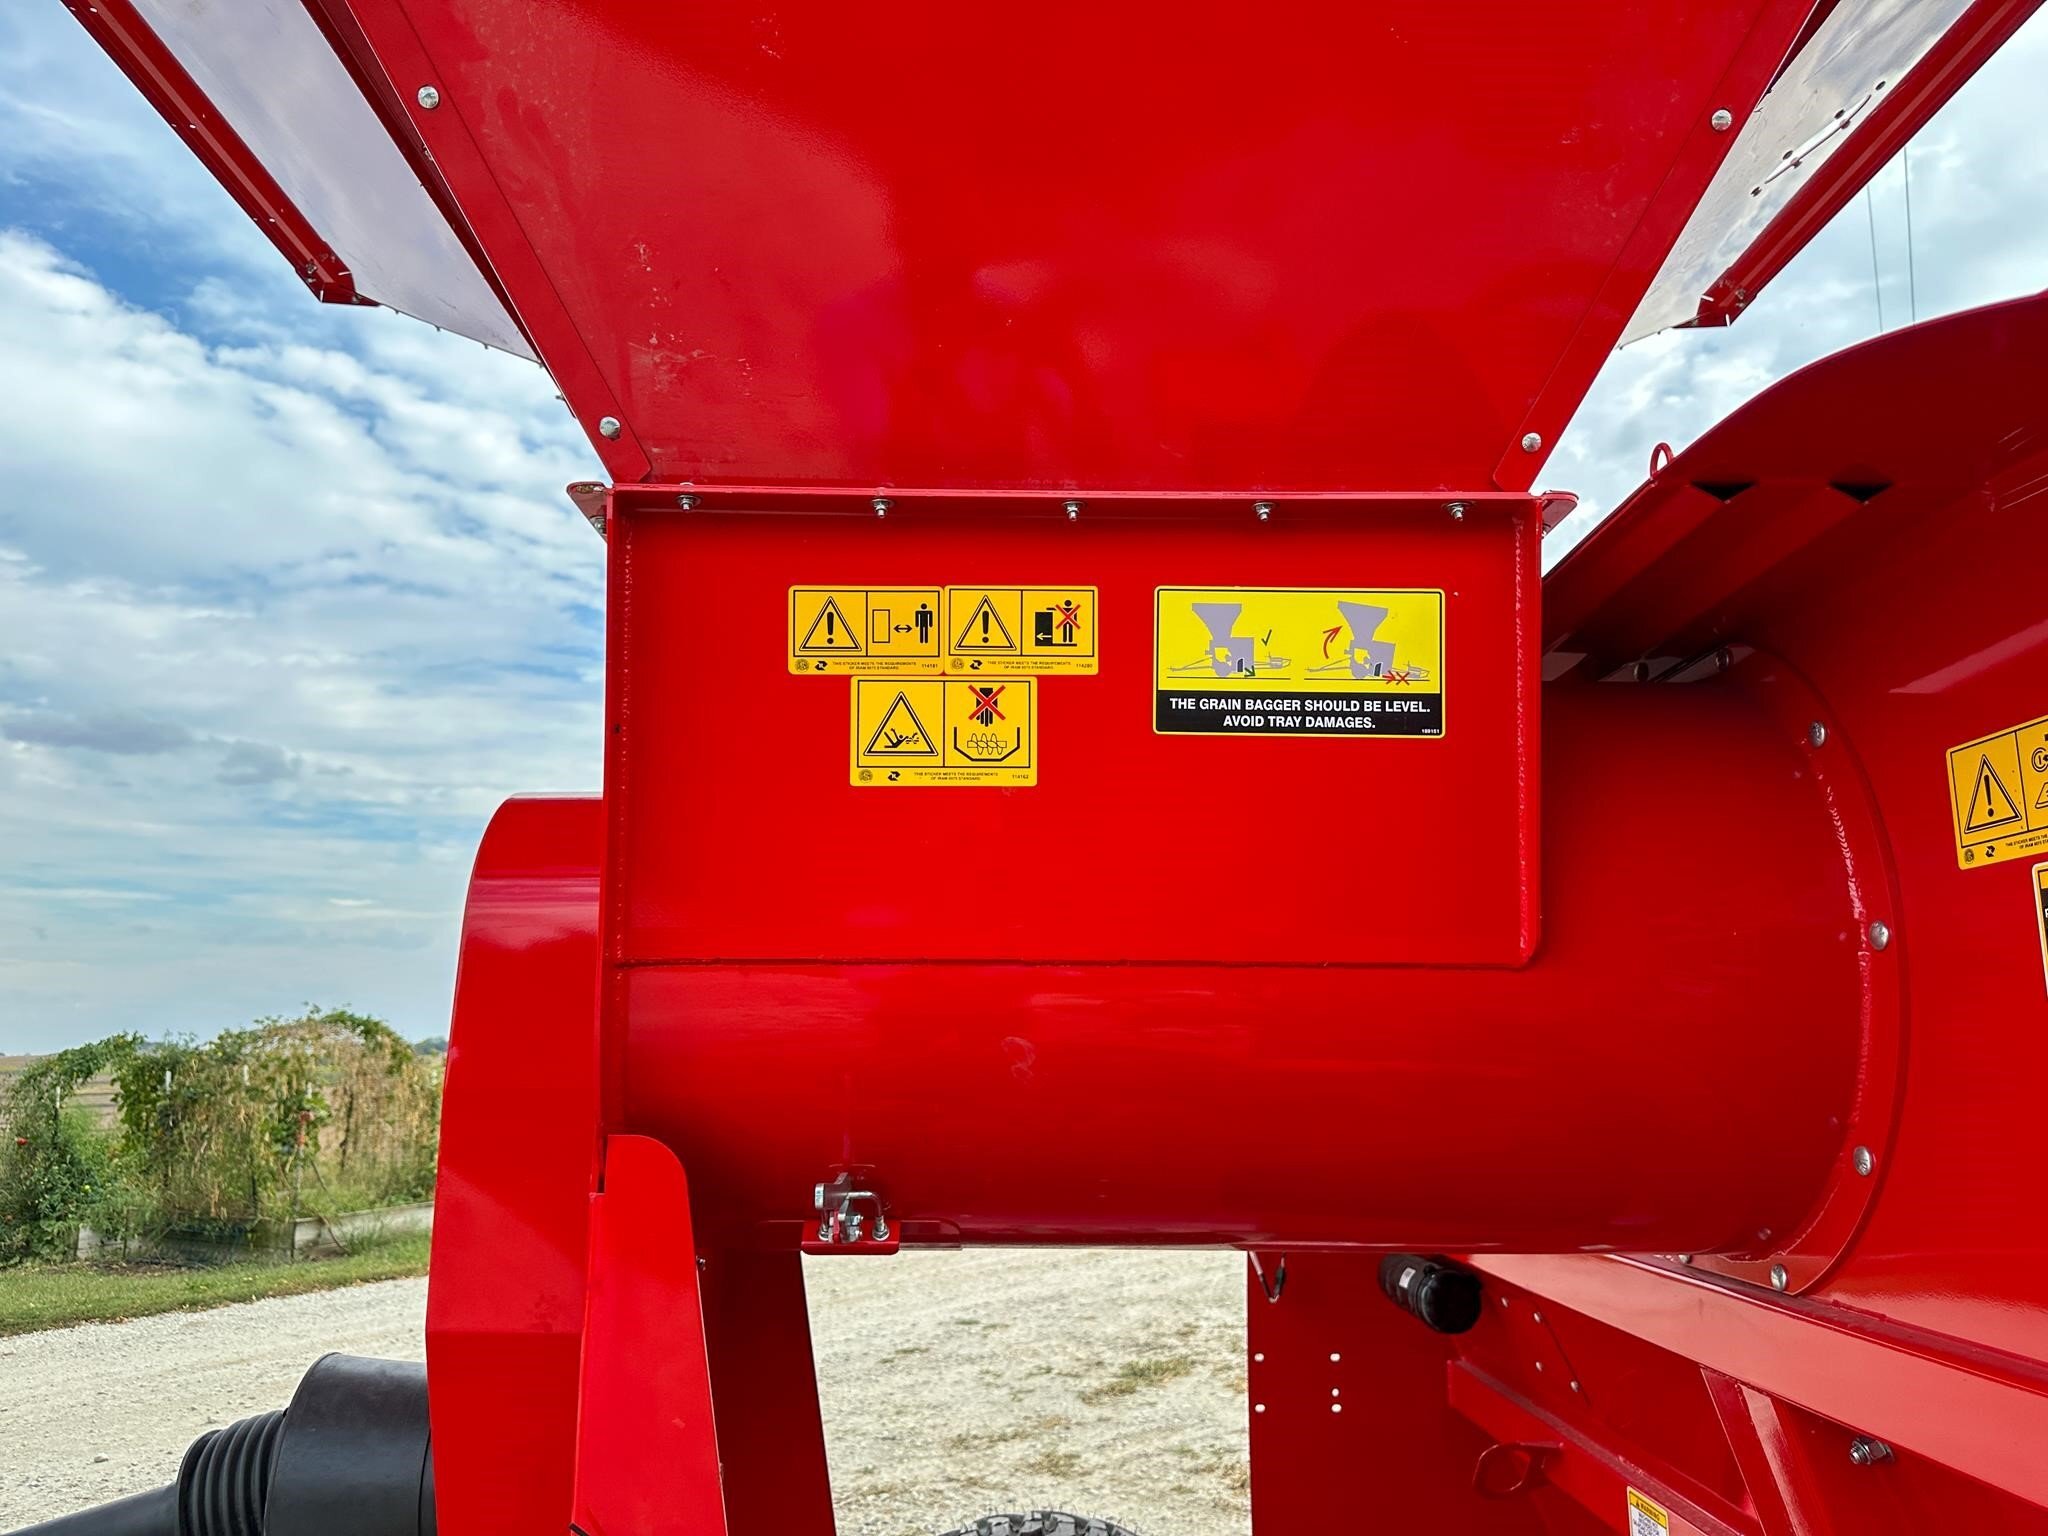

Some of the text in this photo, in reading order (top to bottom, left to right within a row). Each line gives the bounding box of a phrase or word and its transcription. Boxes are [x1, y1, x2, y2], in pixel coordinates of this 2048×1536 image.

[1169, 698, 1431, 713] THE GRAIN BAGGER SHOULD BE LEVEL.
[1223, 715, 1376, 729] AVOID TRAY DAMAGES.
